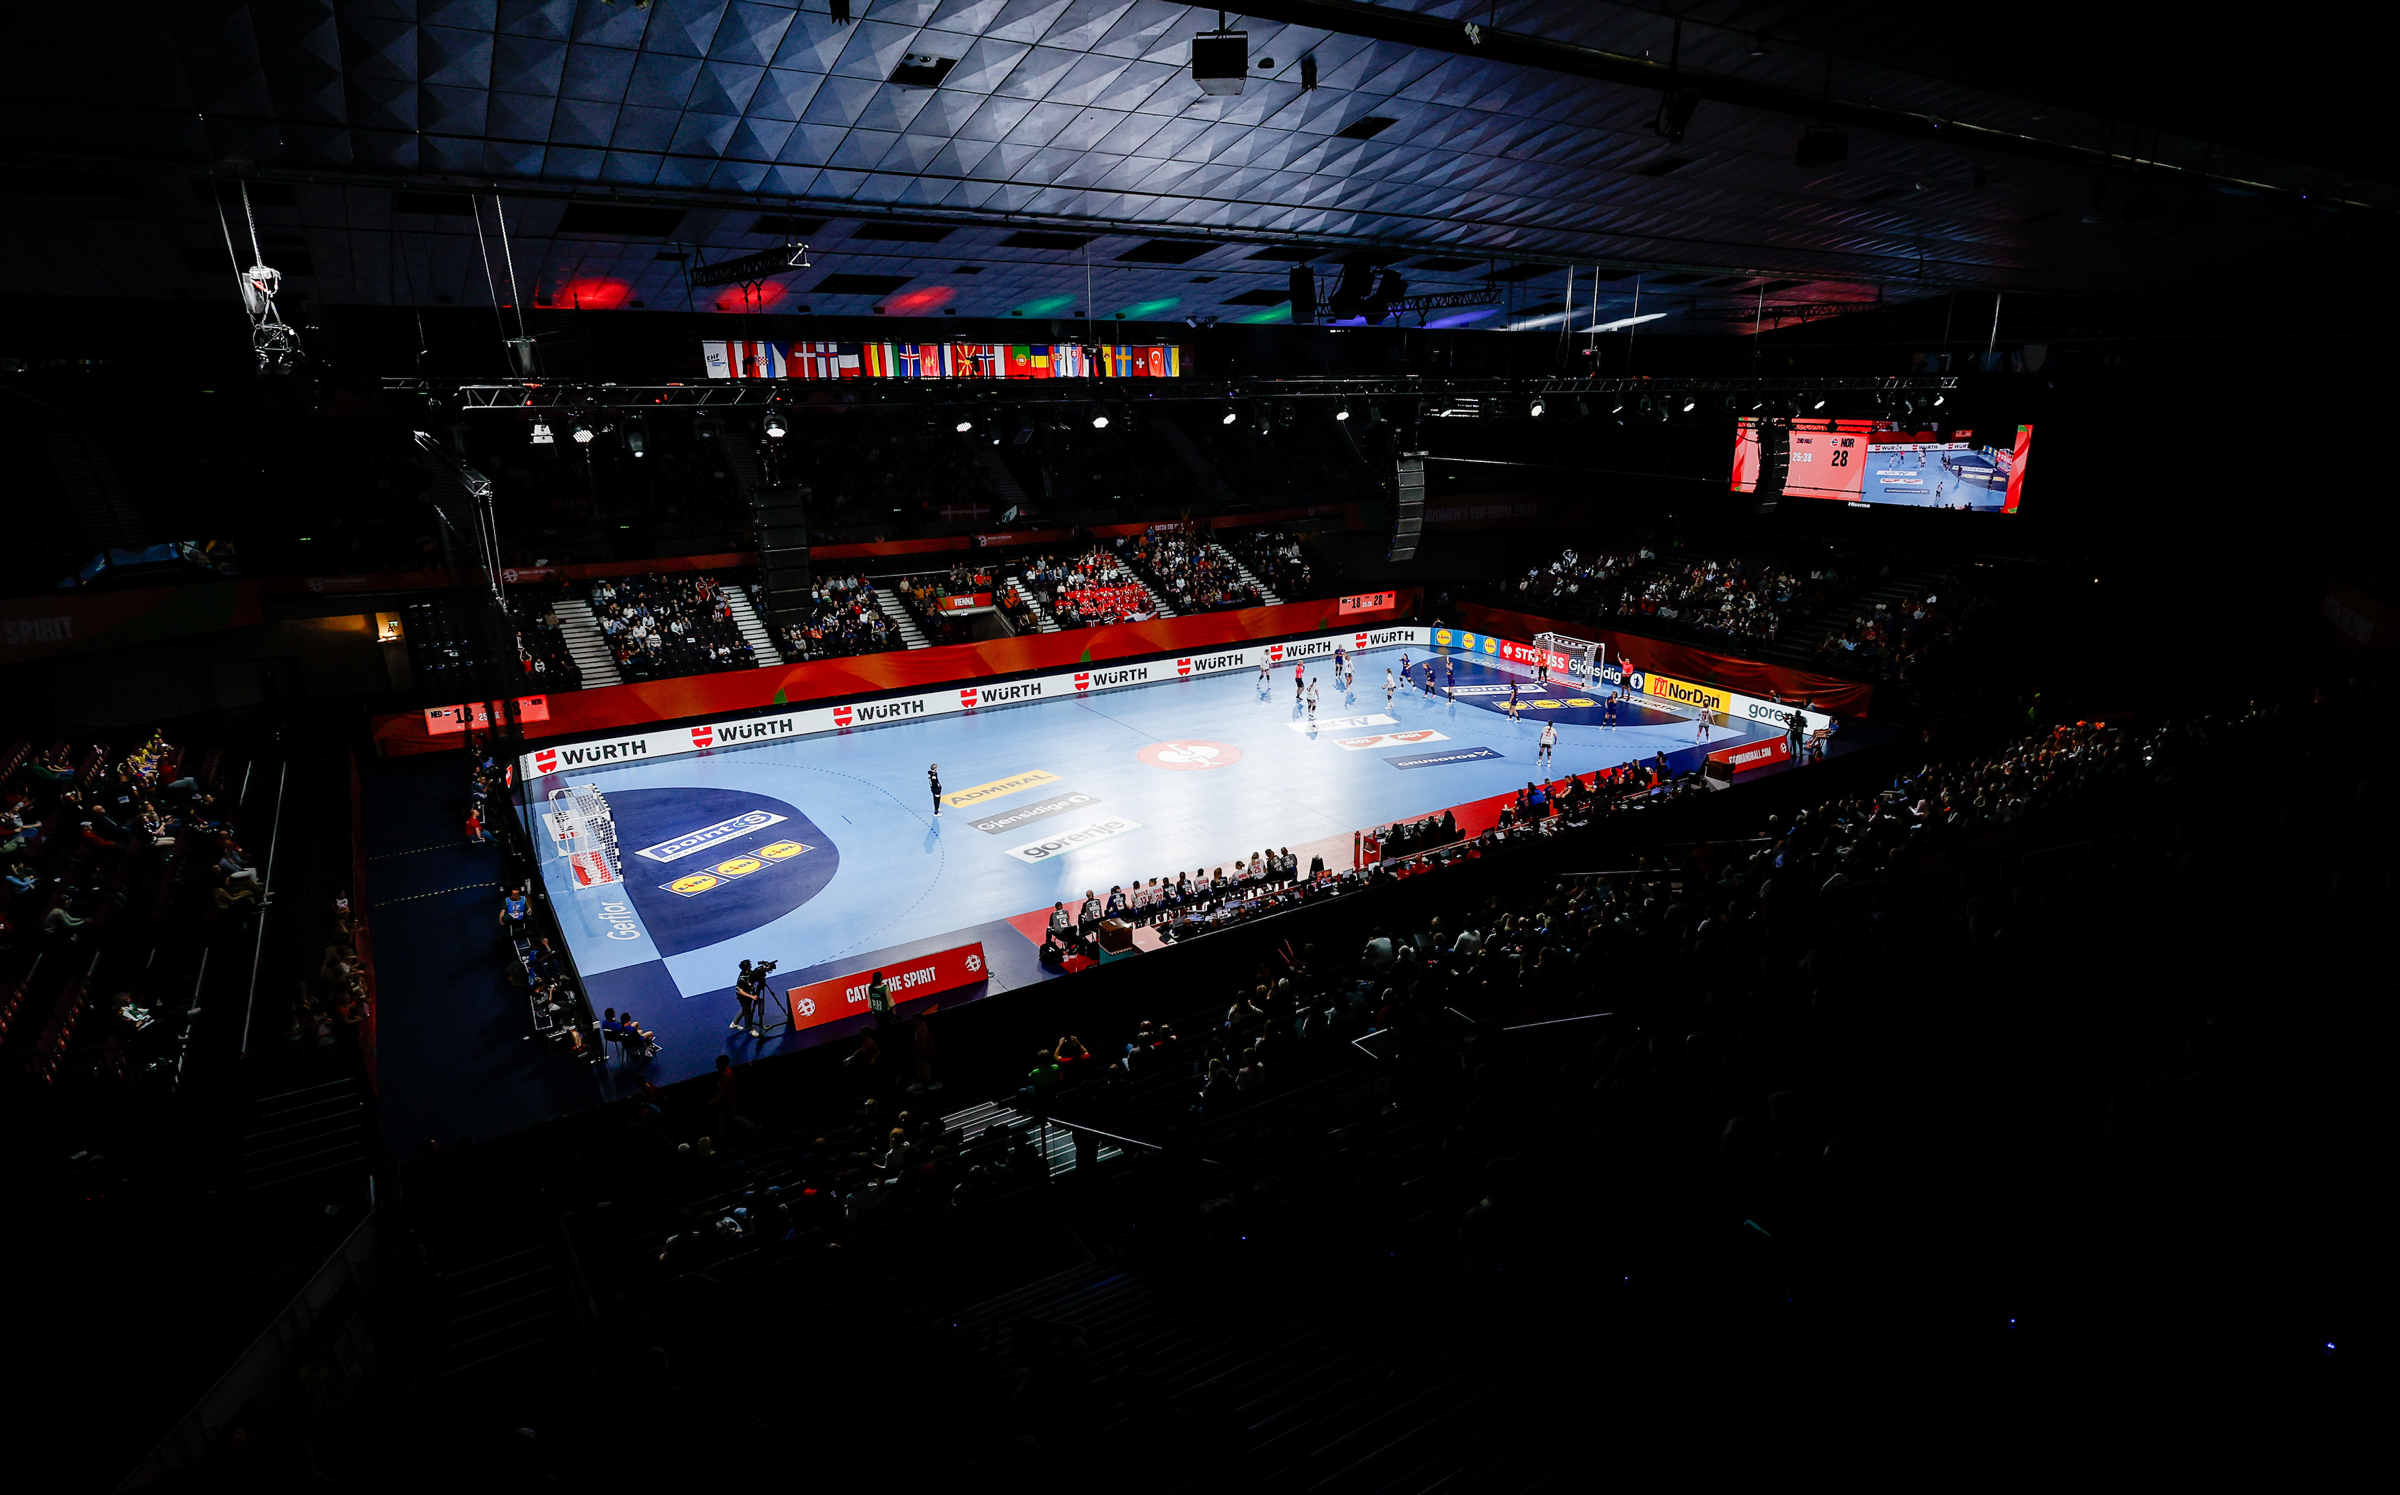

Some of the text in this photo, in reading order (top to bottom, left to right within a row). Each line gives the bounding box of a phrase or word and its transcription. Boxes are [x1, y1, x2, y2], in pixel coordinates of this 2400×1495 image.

[1841, 438, 1855, 448] NOR
[1792, 452, 1812, 462] 25:38
[1831, 450, 1848, 467] 28
[1488, 504, 1512, 519] EURO
[1513, 502, 1538, 516] 2024
[954, 597, 974, 607] VIENNA
[1352, 597, 1361, 608] 18
[1374, 595, 1383, 605] 28
[3, 616, 73, 645] SPIRIT
[1472, 658, 1516, 673] Gerflor
[1568, 659, 1622, 685] Gjensidig
[1669, 683, 1720, 709] NorDan
[454, 706, 474, 724] 18
[1345, 738, 1371, 746] MOL
[1397, 732, 1422, 740] MOL
[1397, 753, 1478, 767] GRUNDFOS
[950, 774, 1053, 804] ADMIRAL
[977, 799, 1071, 831] Gjensidige
[661, 825, 734, 855] point
[1023, 820, 1125, 859] gorenje
[597, 900, 641, 941] Gerflor
[846, 966, 936, 1003] CATC THE SPIRIT
